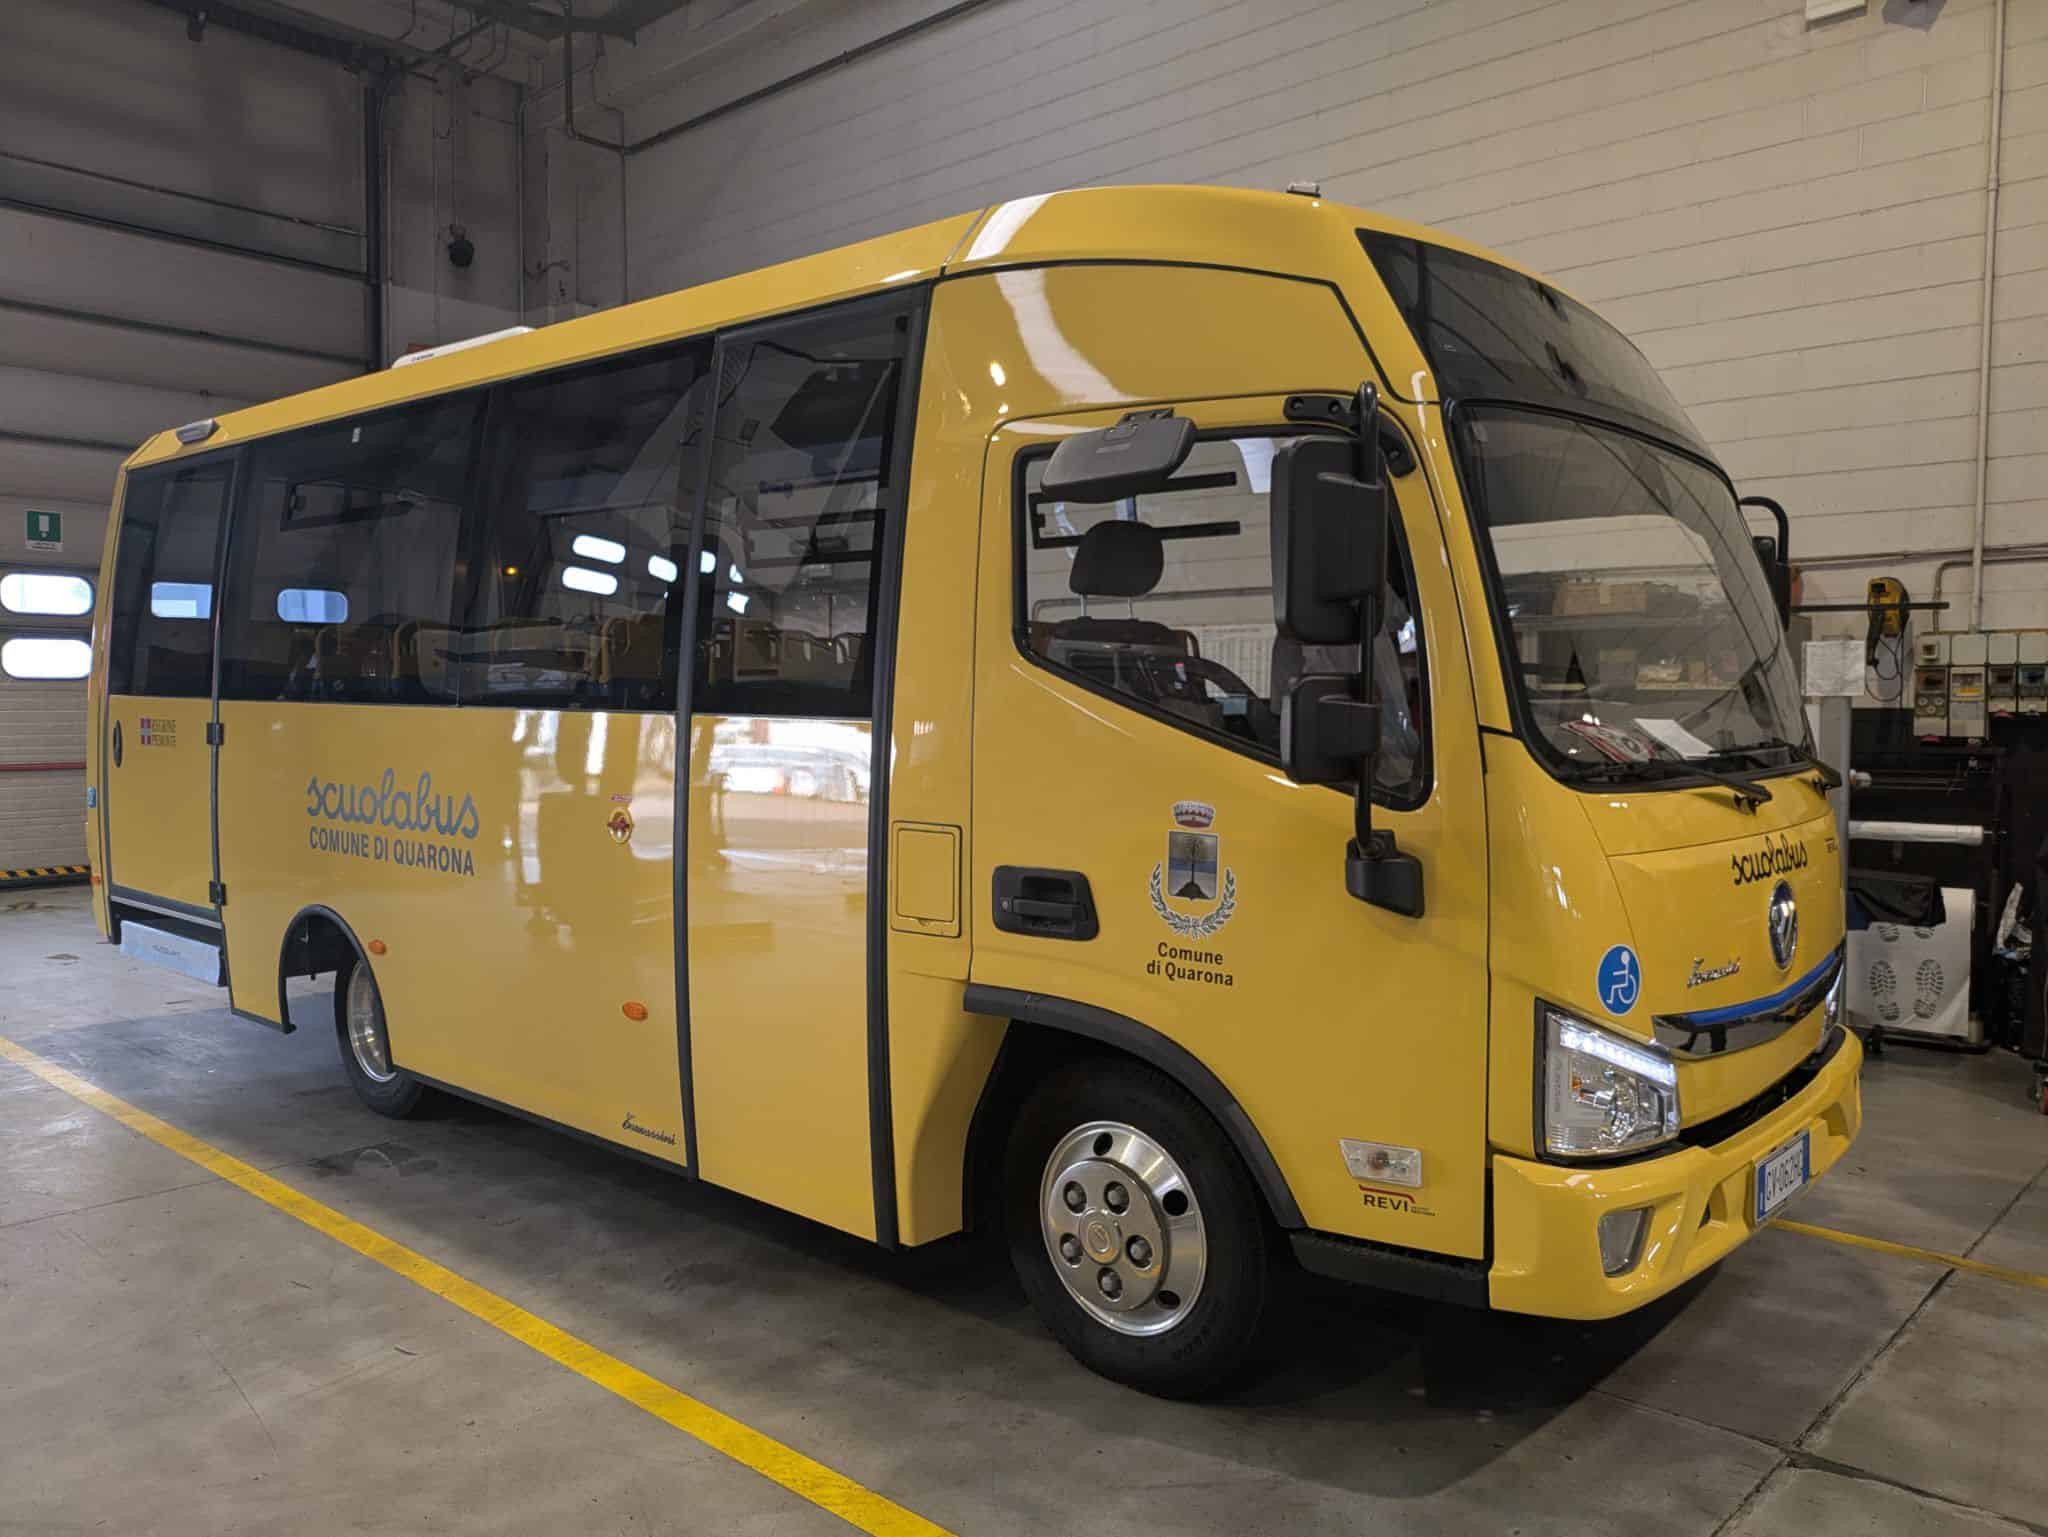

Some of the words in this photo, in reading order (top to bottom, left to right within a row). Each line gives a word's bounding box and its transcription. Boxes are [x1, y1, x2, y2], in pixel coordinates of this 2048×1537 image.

[307, 767, 479, 839] scuolabus
[310, 826, 369, 858] COMUNE
[374, 836, 389, 862] DI
[394, 839, 475, 876] QUARONA
[1732, 834, 1808, 885] scuolabus
[1158, 942, 1224, 965] Comune
[1146, 960, 1161, 975] di
[1165, 962, 1234, 986] Quarona
[1363, 1194, 1409, 1213] REVI
